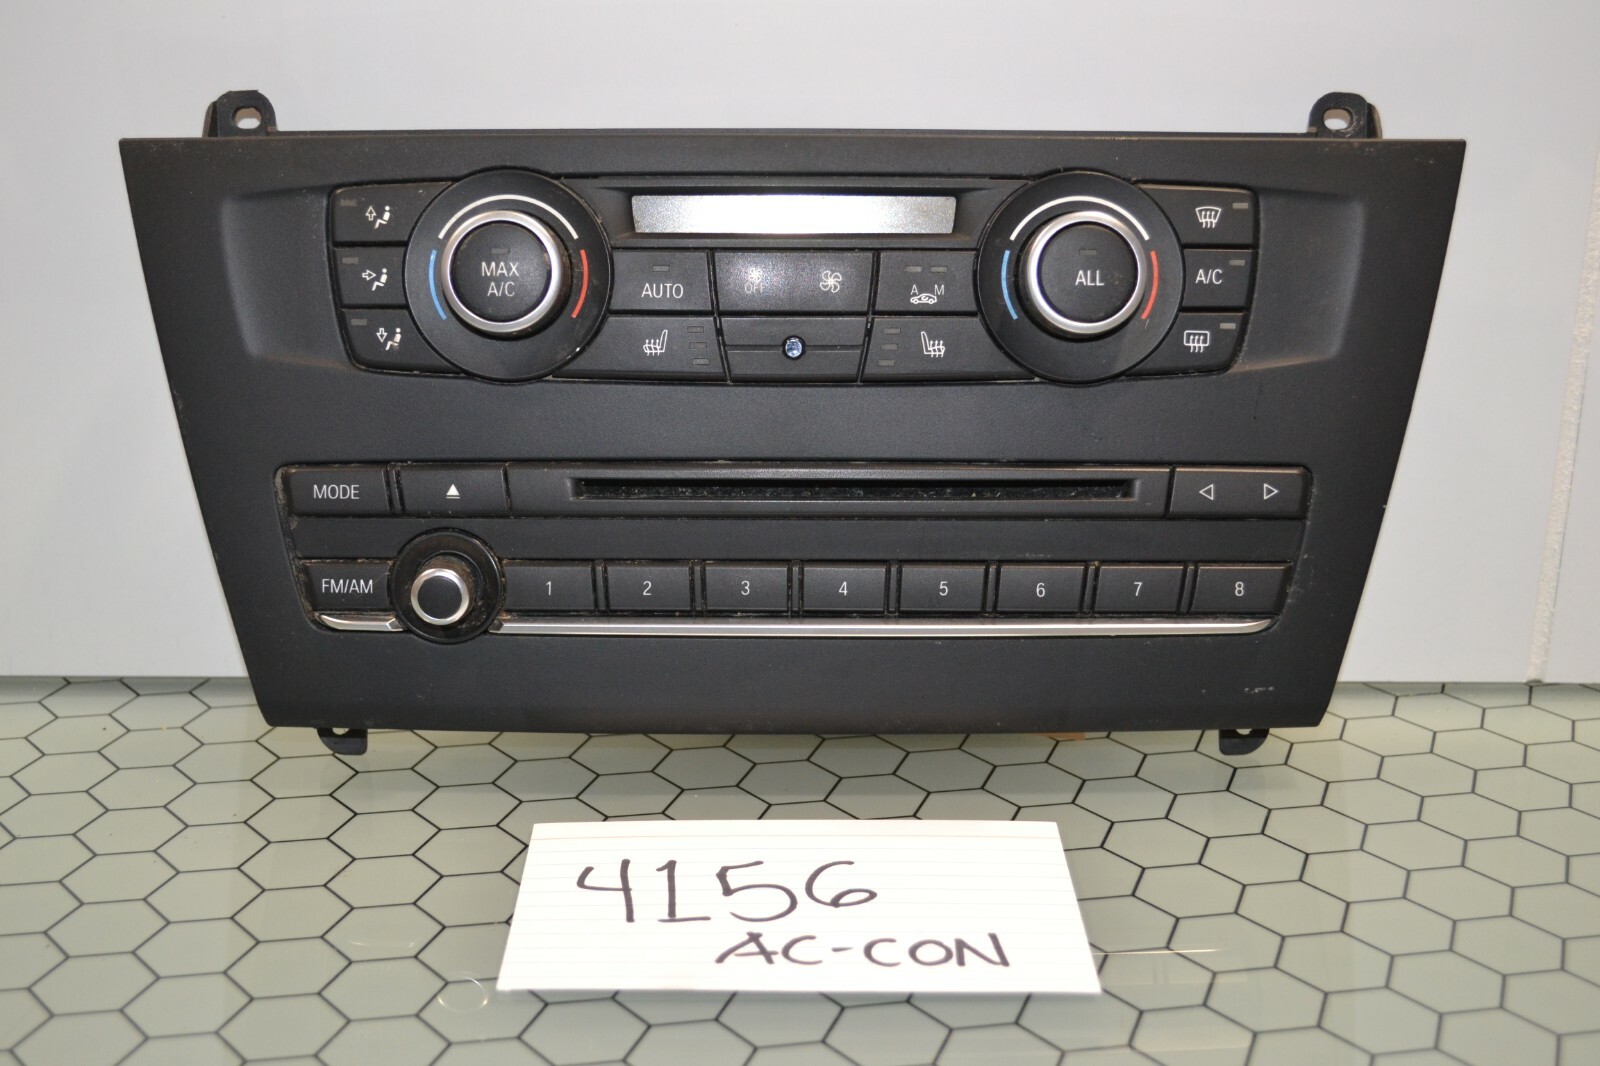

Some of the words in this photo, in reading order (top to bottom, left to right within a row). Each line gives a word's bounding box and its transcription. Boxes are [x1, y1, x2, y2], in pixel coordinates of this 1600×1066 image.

[481, 261, 520, 277] MAX
[1195, 268, 1223, 285] A/C
[1074, 269, 1105, 286] ALL
[487, 280, 515, 297] A/C
[641, 282, 684, 299] AUTO
[744, 282, 766, 295] OFF
[910, 284, 919, 296] A
[934, 284, 945, 296] M
[313, 484, 360, 500] MODE
[321, 578, 373, 594] FM/AM
[642, 580, 652, 596] 2
[741, 580, 750, 596] 3
[838, 581, 848, 596] 4
[939, 580, 949, 596] 5
[1036, 582, 1046, 598] 6
[1133, 581, 1143, 597] 7
[1234, 581, 1245, 597] 8
[576, 858, 878, 923] 4156
[715, 931, 1010, 968] AC-CON
